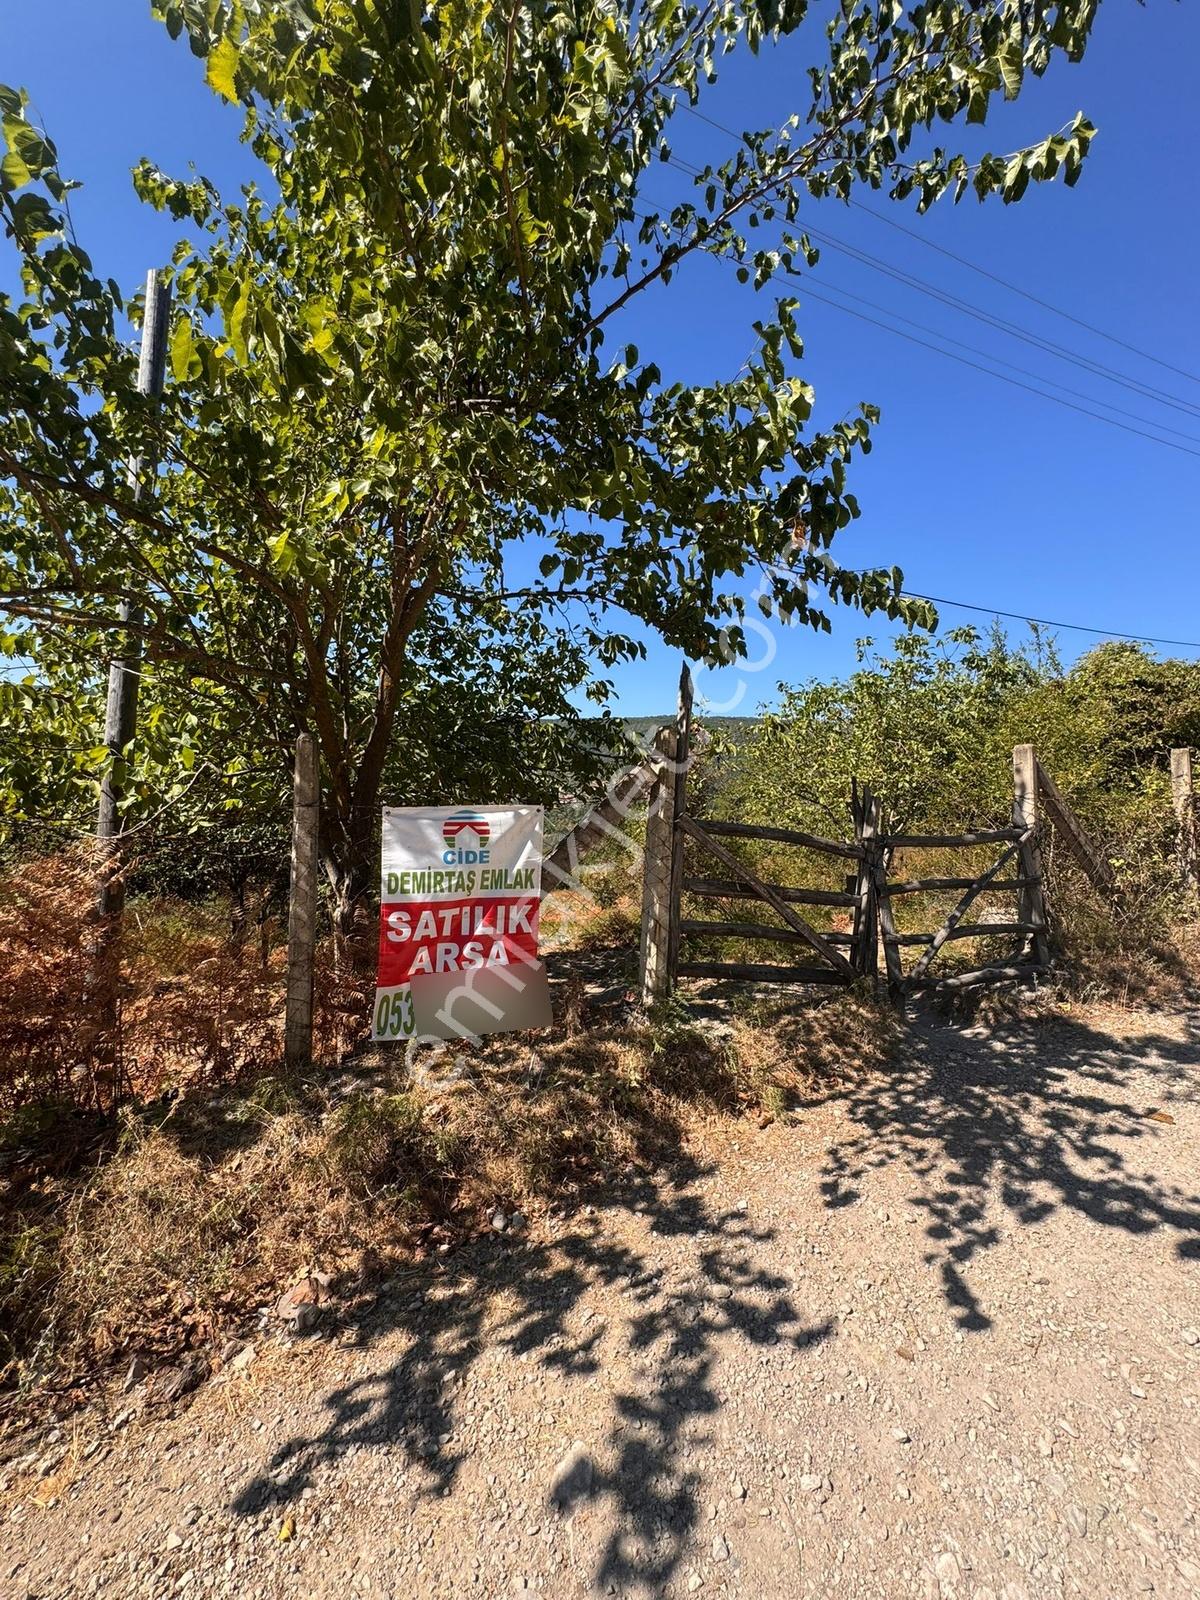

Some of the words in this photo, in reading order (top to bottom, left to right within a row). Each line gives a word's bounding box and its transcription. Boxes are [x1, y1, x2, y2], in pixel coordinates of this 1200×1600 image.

[442, 848, 490, 865] CİDE
[387, 866, 476, 896] DEMİRTAŞ
[480, 868, 535, 890] EMLAK
[387, 905, 532, 942] SATILIK
[407, 940, 509, 976] ARSA
